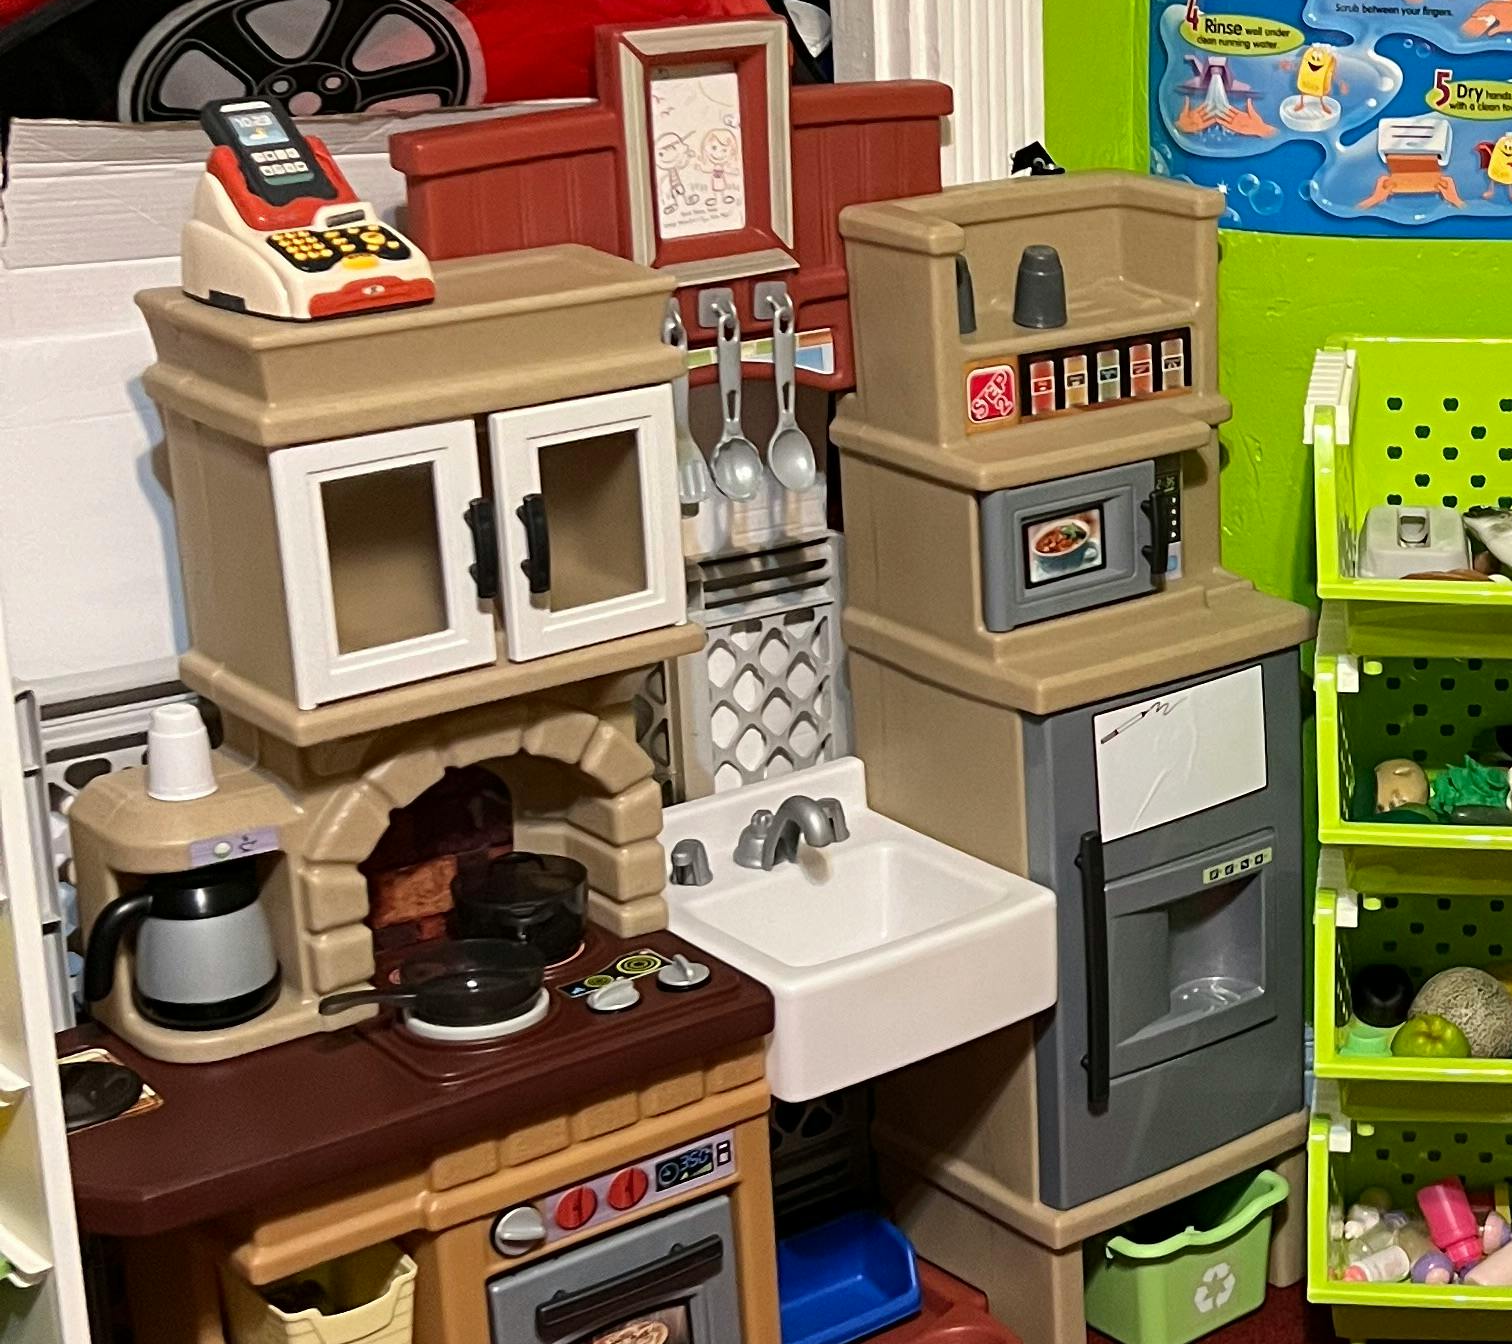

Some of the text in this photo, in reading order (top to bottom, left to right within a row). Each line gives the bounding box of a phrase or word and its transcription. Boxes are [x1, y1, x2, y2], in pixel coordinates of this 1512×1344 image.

[1335, 3, 1454, 19] Scrub between your fingers.
[1204, 17, 1243, 36] Rinse
[1244, 26, 1263, 37] well
[1264, 27, 1292, 38] under
[1196, 35, 1218, 47] clean
[1218, 36, 1251, 50] running
[1435, 70, 1512, 108] 5 Dry hands
[1449, 100, 1468, 112] with
[1476, 102, 1501, 112] clean
[970, 369, 1010, 420] STEP
[995, 393, 1013, 416] 2
